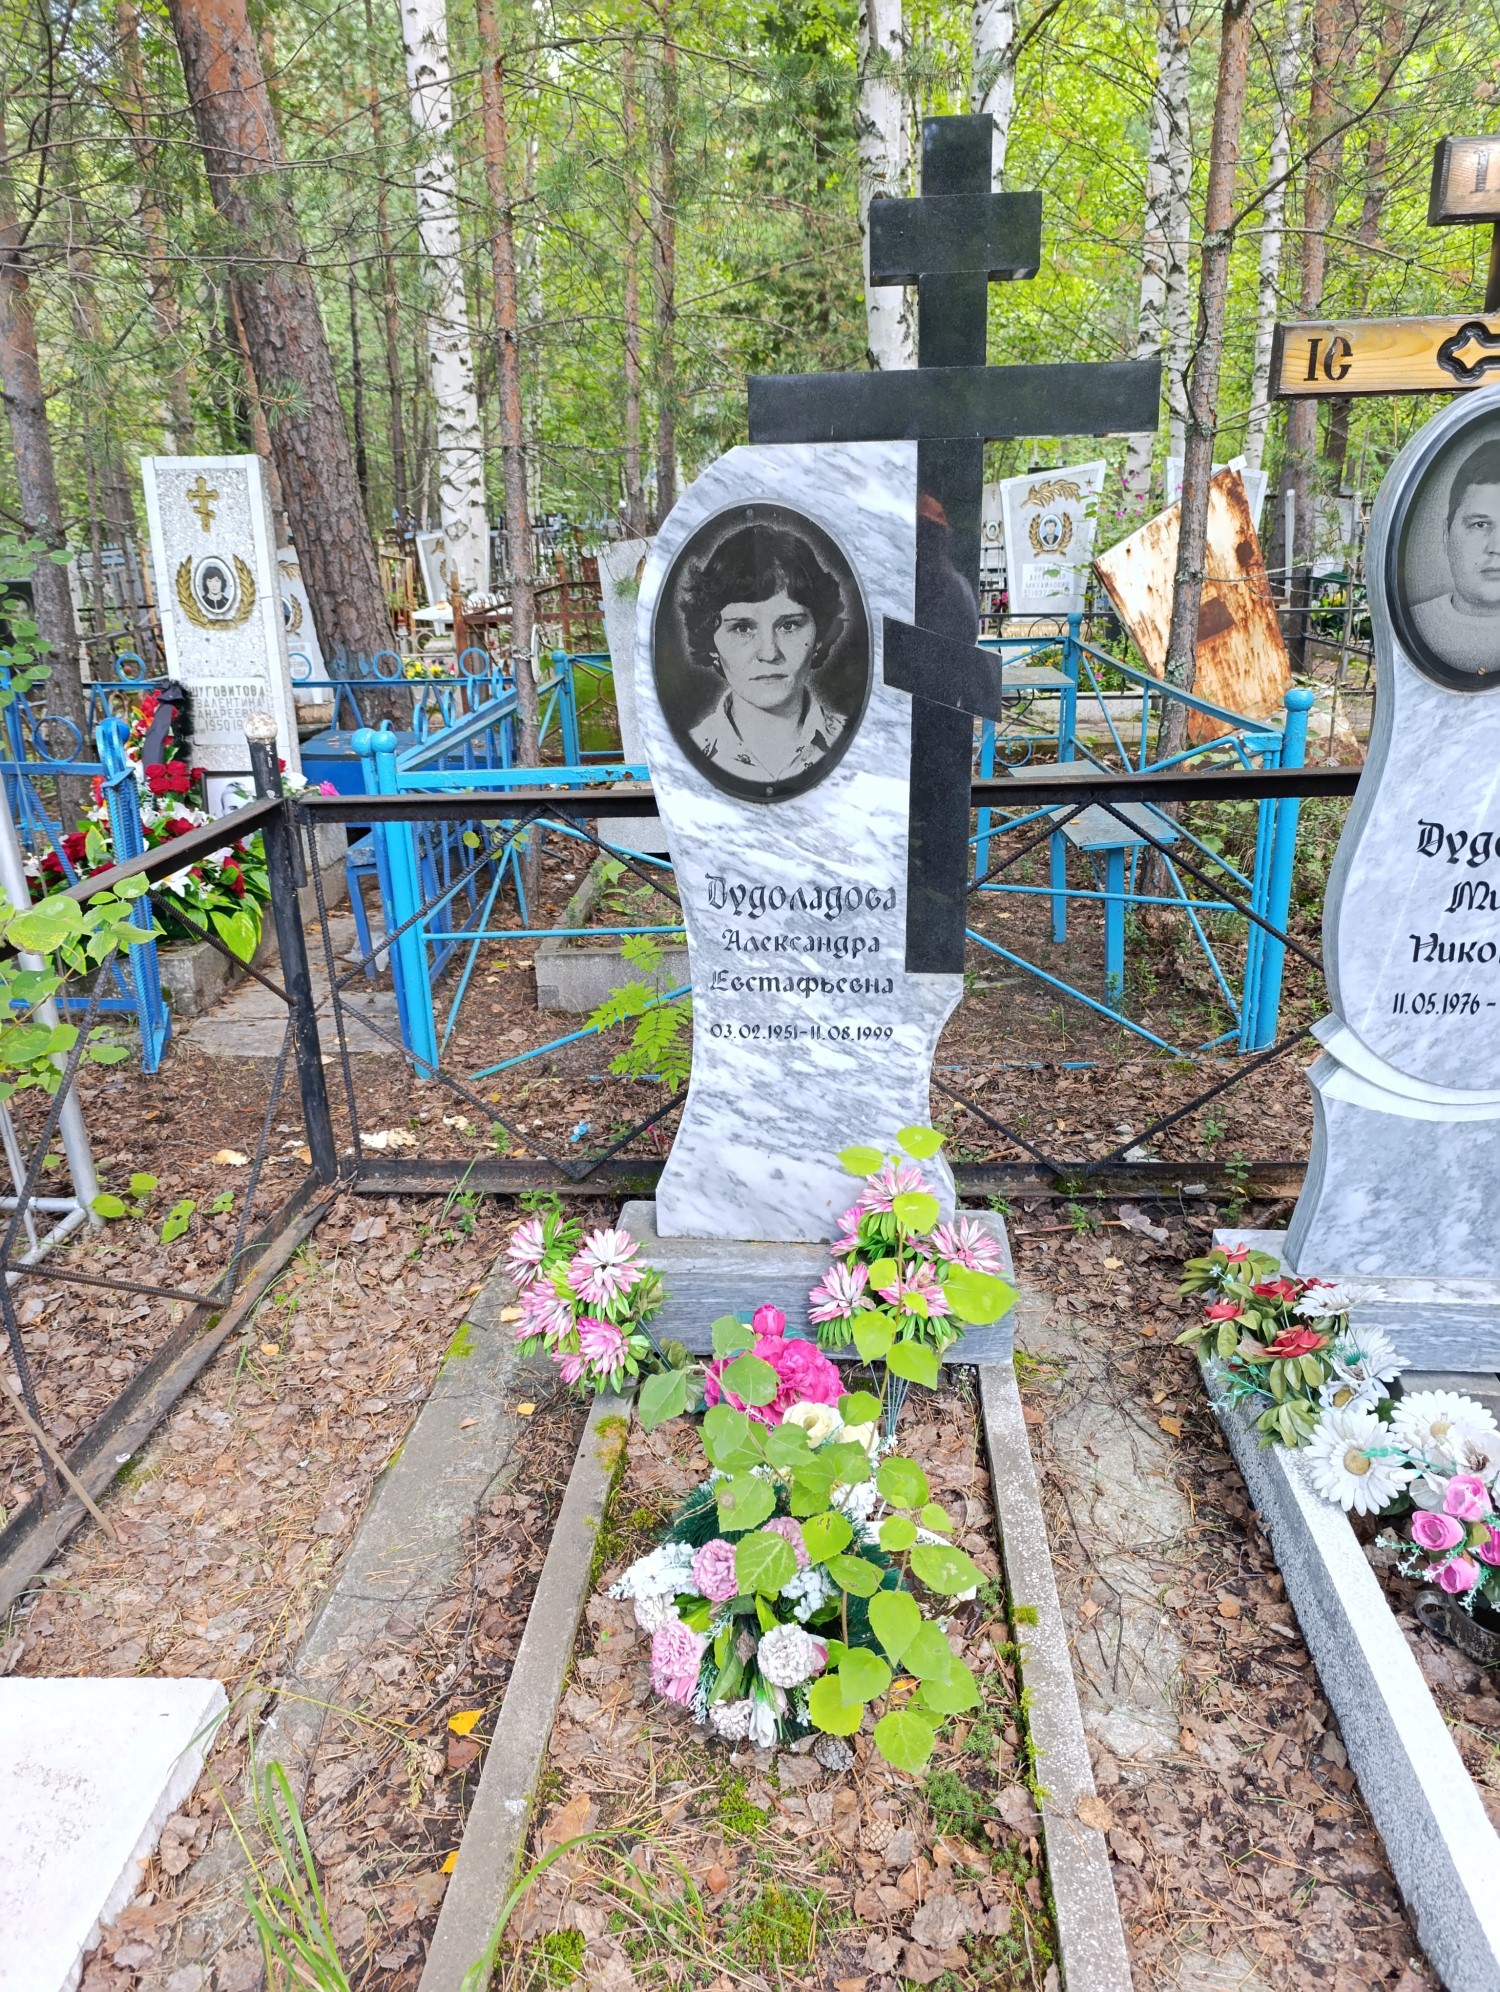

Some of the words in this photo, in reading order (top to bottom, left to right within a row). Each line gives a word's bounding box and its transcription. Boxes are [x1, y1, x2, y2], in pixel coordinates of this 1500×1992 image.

[196, 697, 263, 709] ВАЛЕНТИНА
[198, 708, 253, 720] АНДРЕЕВ
[205, 719, 231, 732] 1950
[704, 872, 897, 921] Дудоладова
[721, 929, 880, 959] Александра
[1409, 932, 1500, 964] Нико
[710, 969, 894, 998] Евстафьевна
